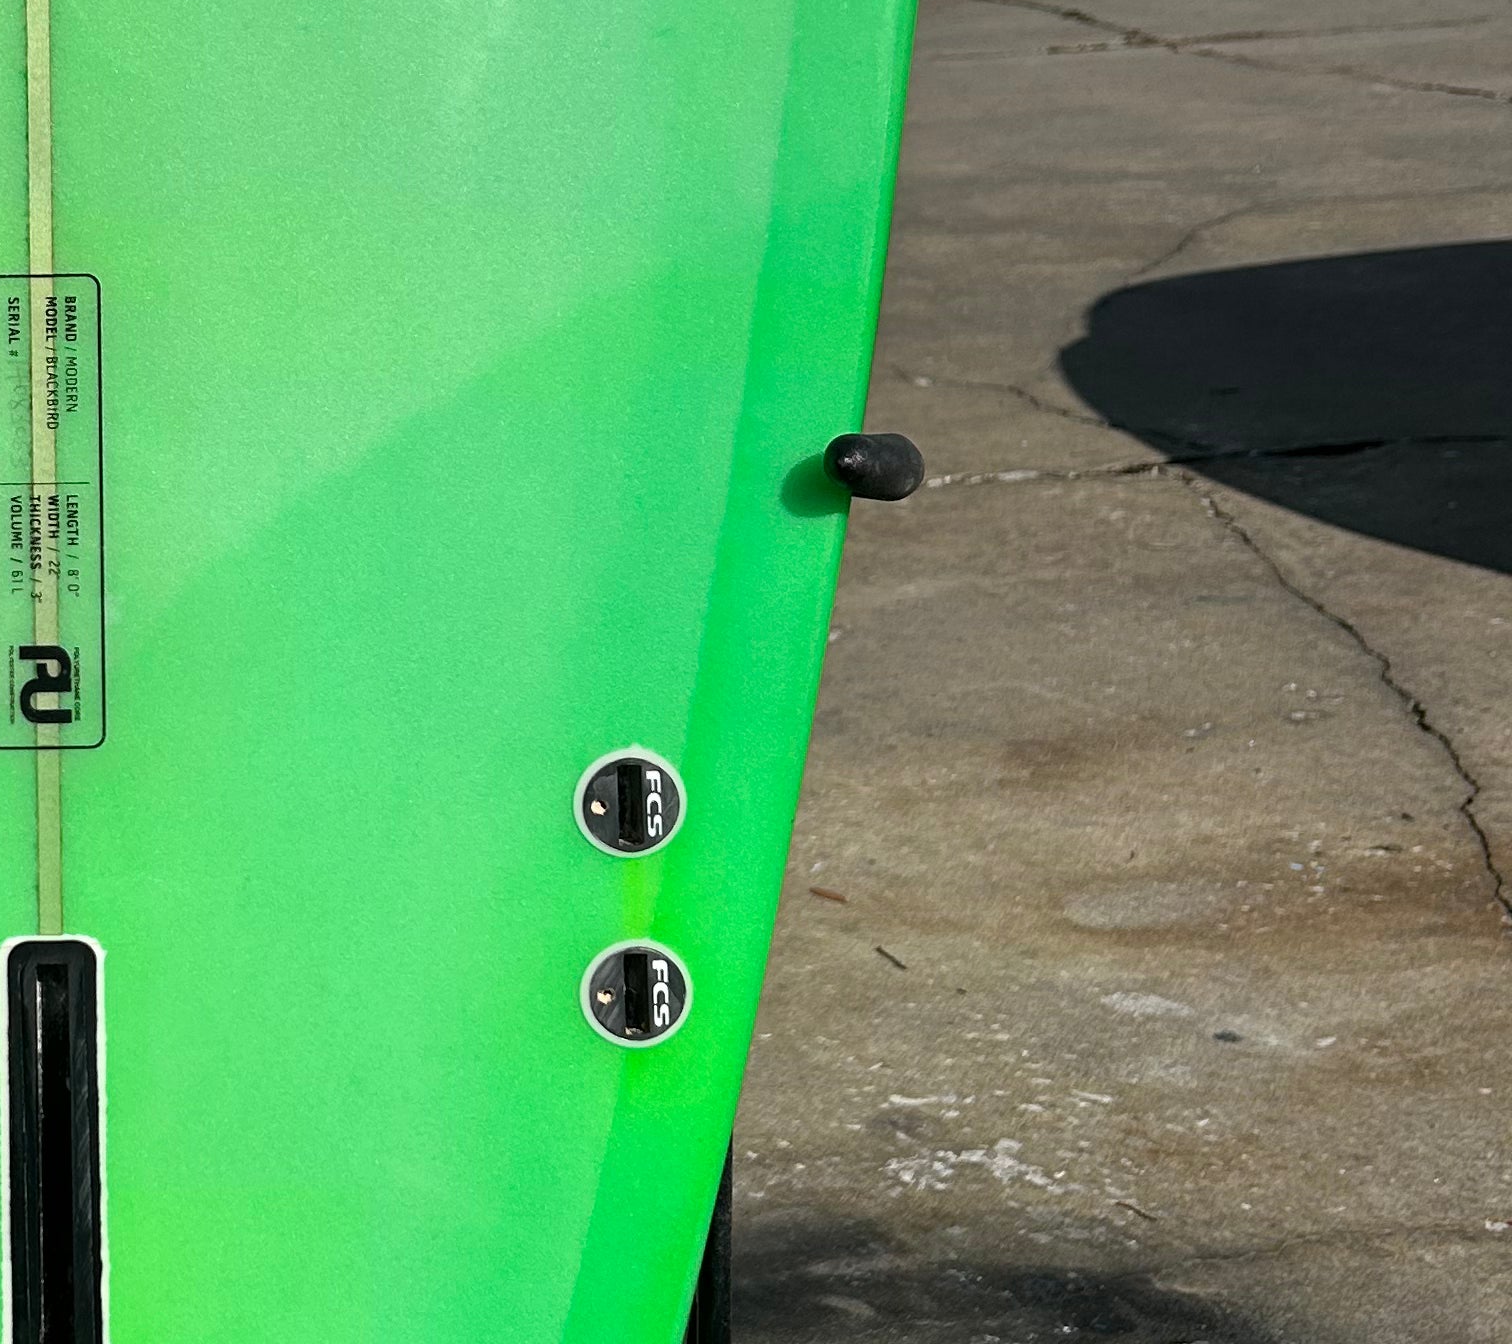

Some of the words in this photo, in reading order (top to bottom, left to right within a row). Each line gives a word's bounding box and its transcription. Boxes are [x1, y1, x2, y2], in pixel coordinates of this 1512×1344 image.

[8, 296, 20, 345] SERIAL
[45, 296, 58, 342] MODEL
[64, 296, 77, 342] BRAND
[45, 356, 59, 430] BLACKBIRD
[65, 357, 78, 413] MODERN
[10, 495, 23, 550] VOLUME
[29, 495, 42, 570] THICKNESS
[47, 495, 60, 539] WIDTH
[66, 494, 79, 546] LENGTH
[645, 769, 663, 838] FCS
[651, 958, 670, 1028] FCS
